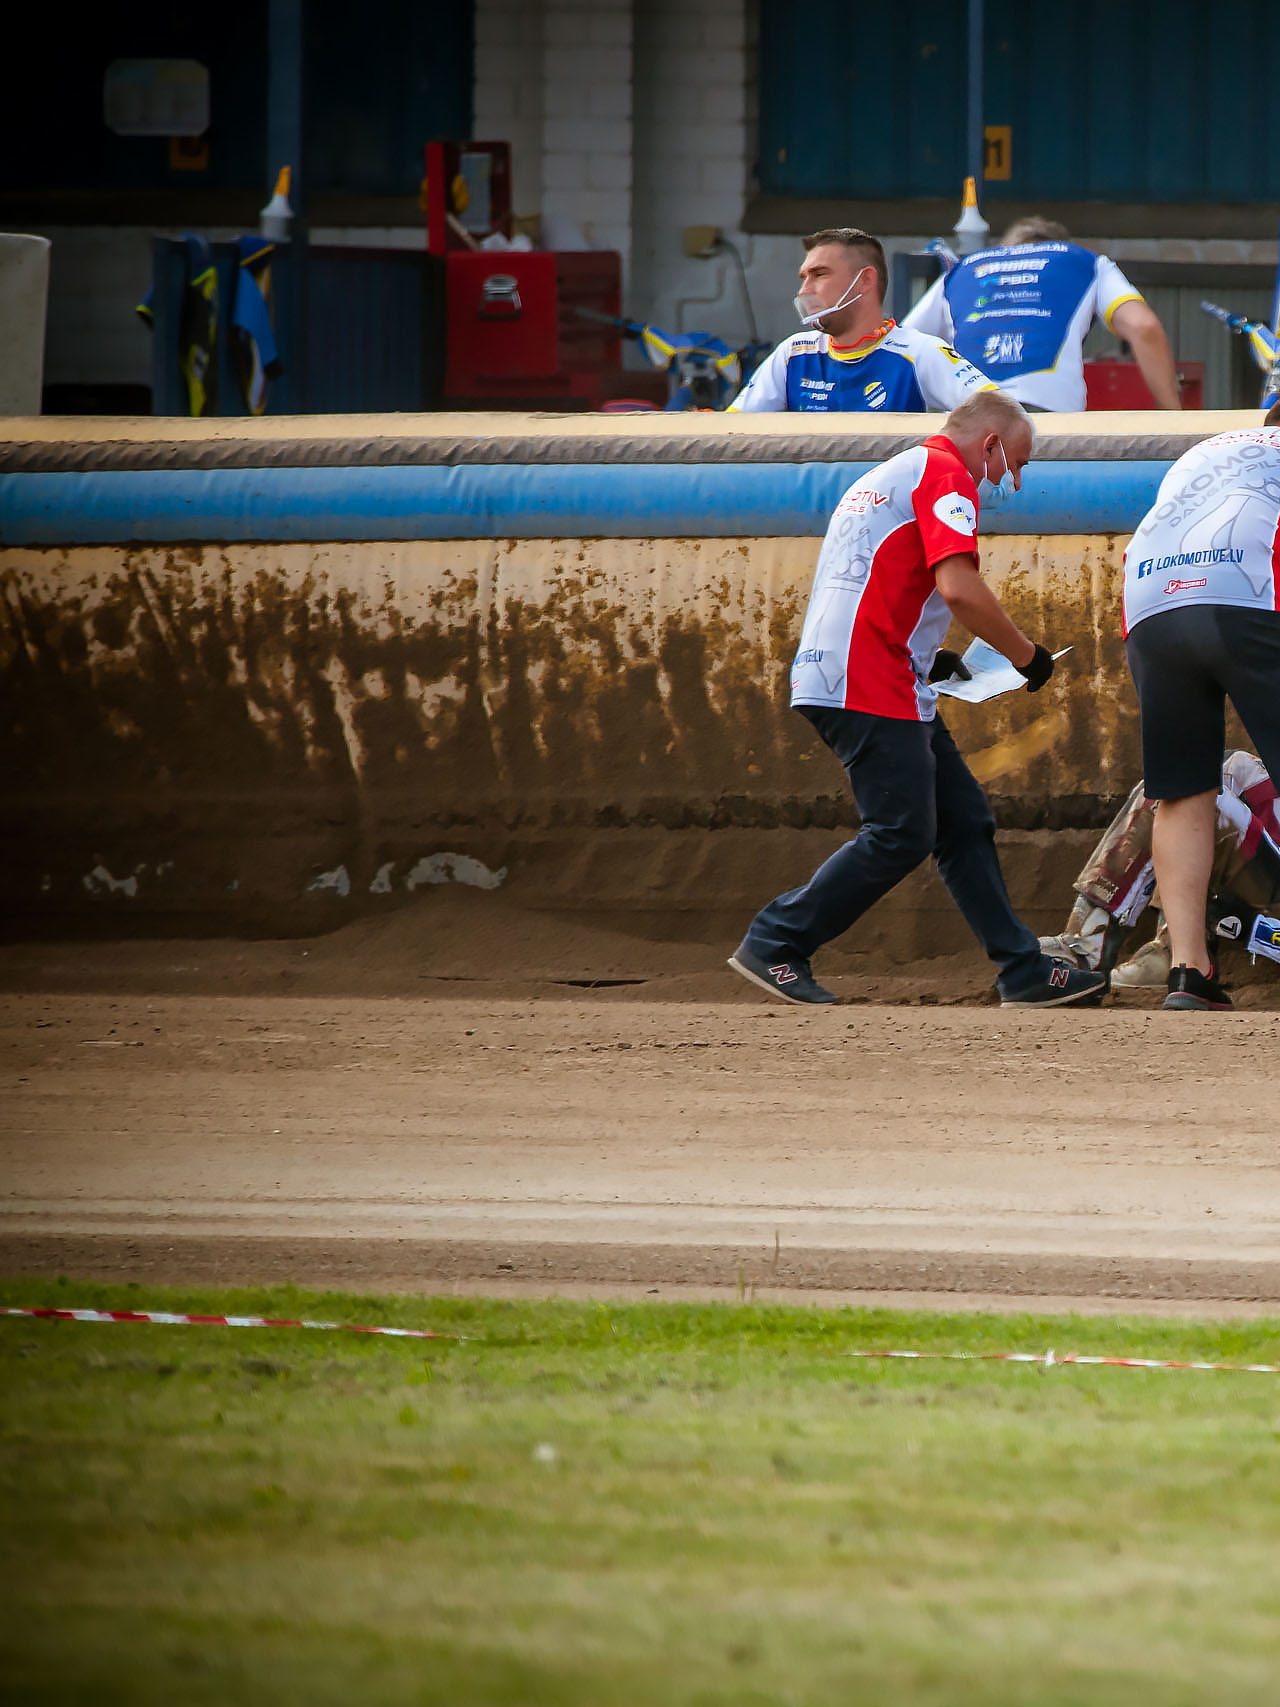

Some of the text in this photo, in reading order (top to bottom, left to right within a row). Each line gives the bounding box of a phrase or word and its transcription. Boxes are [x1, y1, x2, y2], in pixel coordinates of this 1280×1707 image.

[1156, 548, 1244, 570] LOKOMOTIVE.LV
[769, 964, 798, 985] N
[1050, 967, 1070, 988] N
